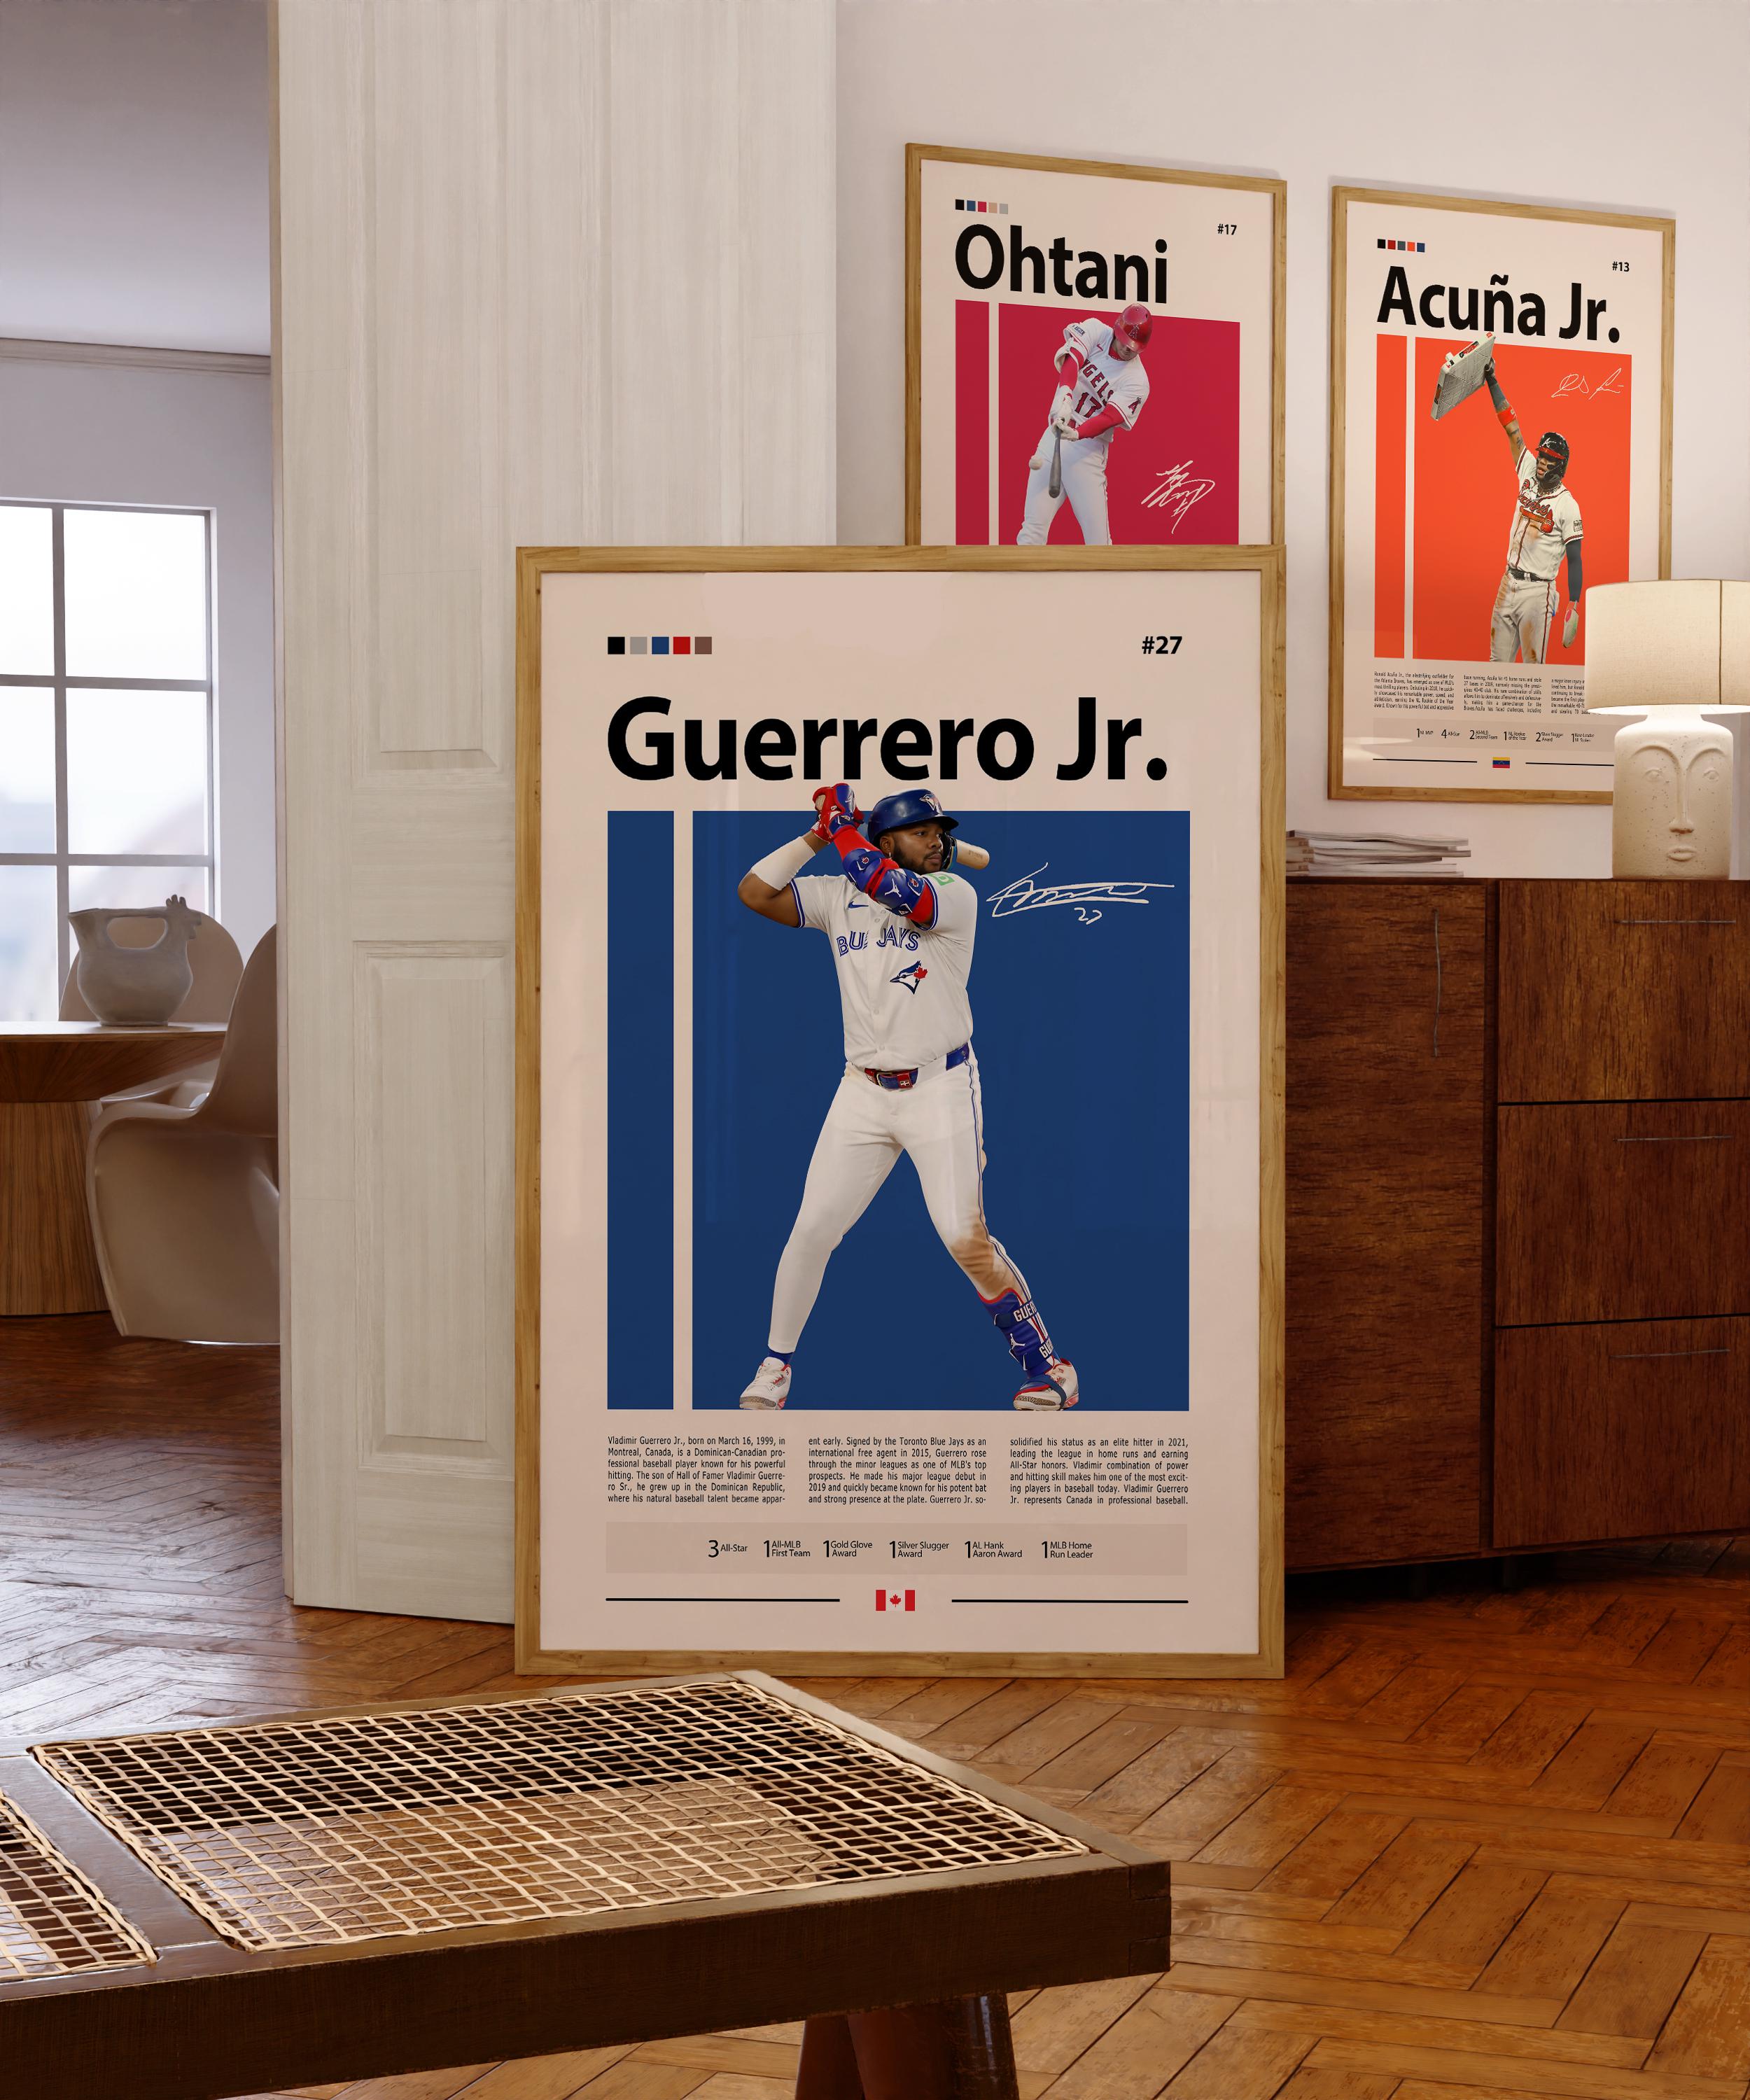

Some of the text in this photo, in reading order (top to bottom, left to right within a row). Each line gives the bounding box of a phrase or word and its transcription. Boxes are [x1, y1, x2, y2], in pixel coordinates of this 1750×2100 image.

[1217, 223, 1237, 235] #17
[955, 223, 1167, 304] Ohtani
[1612, 261, 1630, 272] #13
[1377, 265, 1620, 343] Acuña Jr.
[1075, 392, 1102, 419] 17
[1142, 636, 1182, 654] #27
[608, 696, 1167, 780] Guerrero Jr.
[1441, 729, 1447, 738] 4
[1469, 729, 1475, 739] 2
[1536, 732, 1541, 742] 2
[876, 925, 920, 951] JAYS
[608, 1436, 637, 1444] Vladimir
[640, 1436, 671, 1445] Guerrero
[673, 1436, 685, 1446] Jr.,
[689, 1436, 704, 1445] born
[718, 1436, 739, 1445] March
[743, 1436, 753, 1446] 16,
[757, 1436, 776, 1446] 1999,
[779, 1436, 785, 1445] in
[823, 1436, 843, 1447] early.
[846, 1436, 870, 1447] Signed
[874, 1436, 882, 1447] by
[885, 1436, 896, 1445] the
[899, 1437, 927, 1446] Toronto
[931, 1437, 945, 1446] Blue
[948, 1437, 964, 1448] Jays
[1011, 1437, 1042, 1446] solidified
[1047, 1438, 1057, 1446] his
[1062, 1438, 1084, 1446] status
[1113, 1438, 1128, 1446] elite
[1133, 1438, 1153, 1446] hitter
[1158, 1438, 1163, 1446] in
[1168, 1438, 1188, 1448] 2021,
[608, 1448, 641, 1457] Montreal,
[645, 1448, 673, 1457] Canada,
[678, 1448, 683, 1456] is
[694, 1447, 766, 1456] Dominican-Canadian
[771, 1450, 785, 1458] pro-
[809, 1448, 854, 1457] international
[858, 1448, 872, 1457] free
[876, 1449, 897, 1459] agent
[912, 1448, 931, 1459] 2015,
[936, 1448, 967, 1457] Guerrero
[1011, 1449, 1036, 1460] leading
[1042, 1449, 1053, 1457] the
[1058, 1449, 1081, 1460] league
[1098, 1449, 1117, 1458] home
[1143, 1449, 1156, 1458] and
[1161, 1450, 1188, 1460] earning
[608, 1459, 639, 1467] fessional
[676, 1460, 697, 1469] player
[701, 1460, 723, 1468] known
[727, 1460, 737, 1468] for
[741, 1460, 751, 1468] his
[755, 1460, 785, 1470] powerful
[808, 1460, 836, 1470] through
[856, 1460, 876, 1469] minor
[881, 1460, 907, 1470] leagues
[940, 1460, 947, 1469] of
[951, 1460, 971, 1469] MLB's
[975, 1461, 986, 1471] top
[1042, 1461, 1068, 1469] honors.
[1073, 1461, 1102, 1469] Vladimir
[1107, 1461, 1150, 1469] combination
[1155, 1461, 1162, 1469] of
[1167, 1463, 1189, 1471] power
[608, 1471, 633, 1481] hitting.
[636, 1471, 650, 1479] The
[667, 1471, 674, 1479] of
[677, 1471, 690, 1479] Hall
[693, 1471, 700, 1480] of
[703, 1471, 724, 1480] Famer
[727, 1471, 756, 1480] Vladimir
[758, 1471, 785, 1480] Guerre-
[809, 1471, 986, 1483] prospects. He made his major league debut in
[708, 1540, 719, 1558] 3
[764, 1540, 769, 1558] 1
[771, 1540, 801, 1548] All-MLB
[823, 1540, 829, 1558] 1
[831, 1541, 872, 1550] Gold Glove
[890, 1541, 895, 1558] 1
[898, 1541, 949, 1551] Silver Slugger
[965, 1541, 970, 1558] 1
[1042, 1541, 1047, 1558] 1
